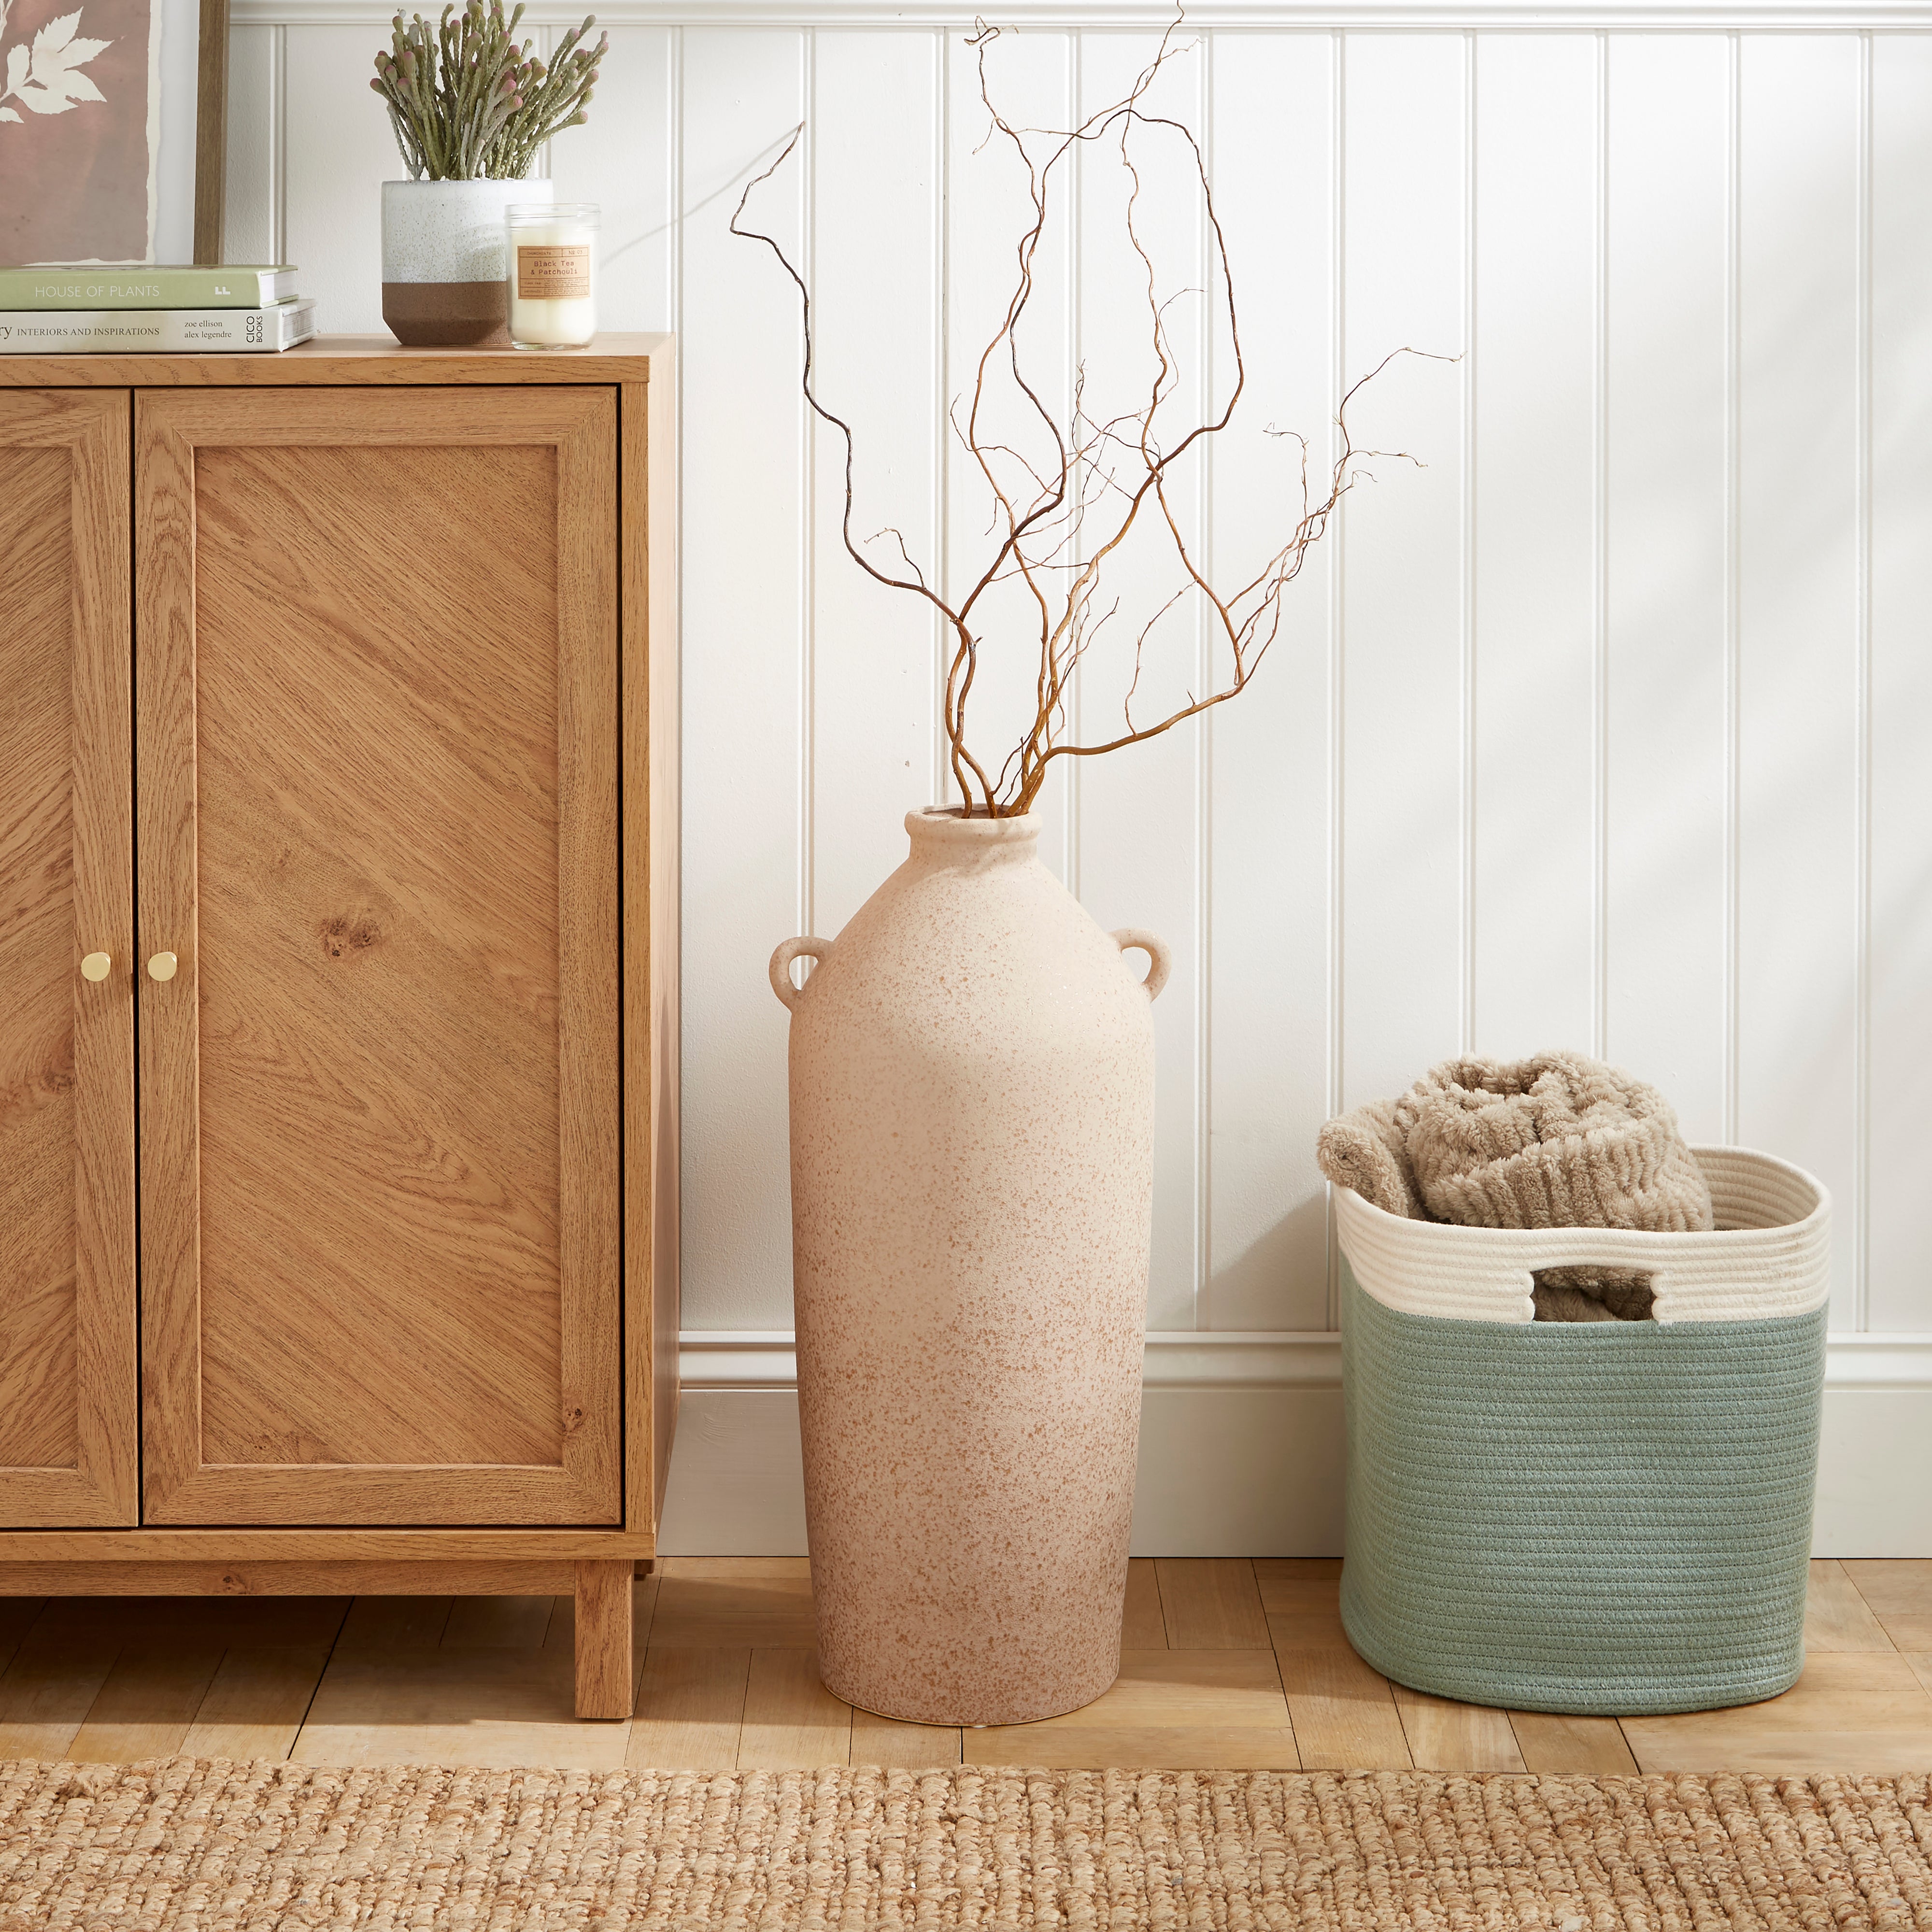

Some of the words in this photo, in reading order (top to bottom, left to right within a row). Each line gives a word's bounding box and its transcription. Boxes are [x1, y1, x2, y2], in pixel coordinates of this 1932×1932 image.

[35, 286, 81, 297] HOUSE
[87, 286, 104, 297] OF
[110, 286, 160, 297] PLANTS
[94, 327, 160, 336] INSPIRATIONS
[246, 316, 255, 343] CICO
[201, 331, 232, 340] legendre
